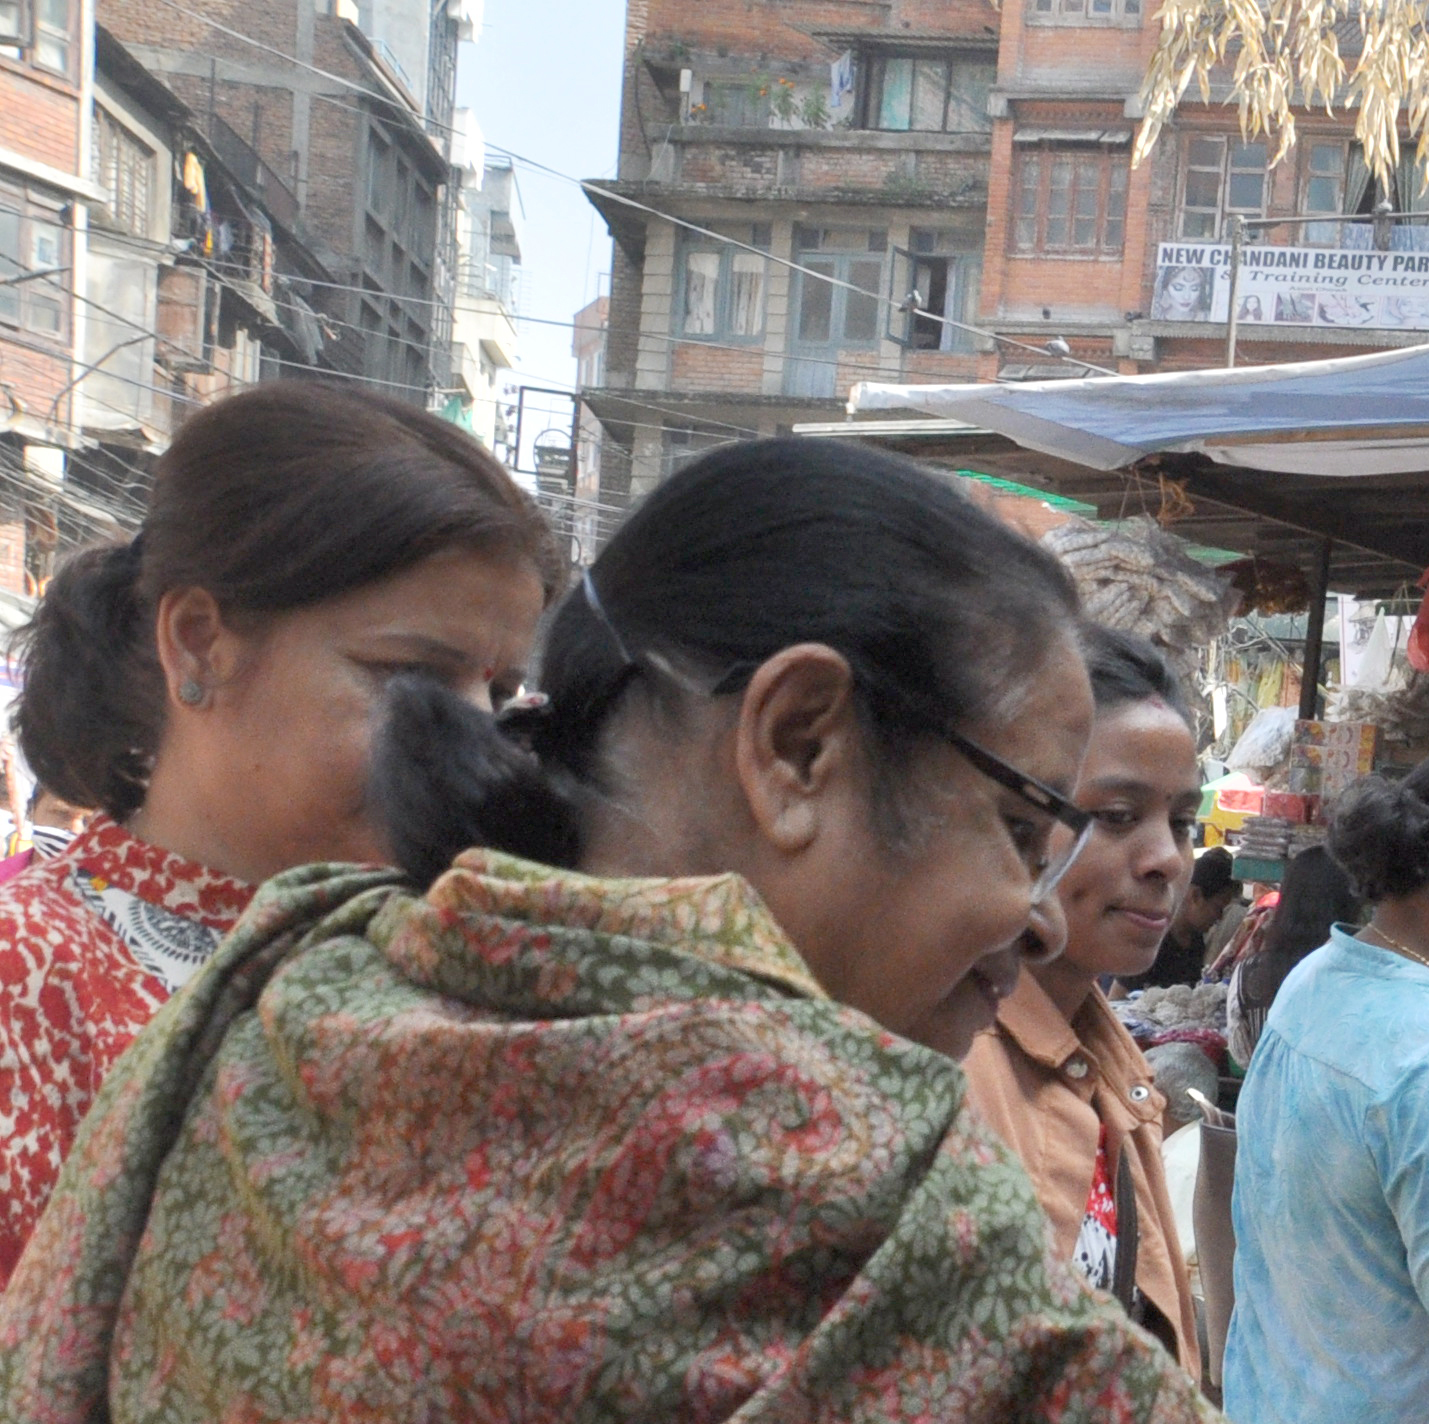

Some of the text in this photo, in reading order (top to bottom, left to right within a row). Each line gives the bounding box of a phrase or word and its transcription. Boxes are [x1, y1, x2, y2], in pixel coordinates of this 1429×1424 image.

[1161, 247, 1205, 264] NEW
[1210, 248, 1310, 269] CHANDANI
[1313, 252, 1388, 272] BEAUTY
[1249, 271, 1348, 287] Training
